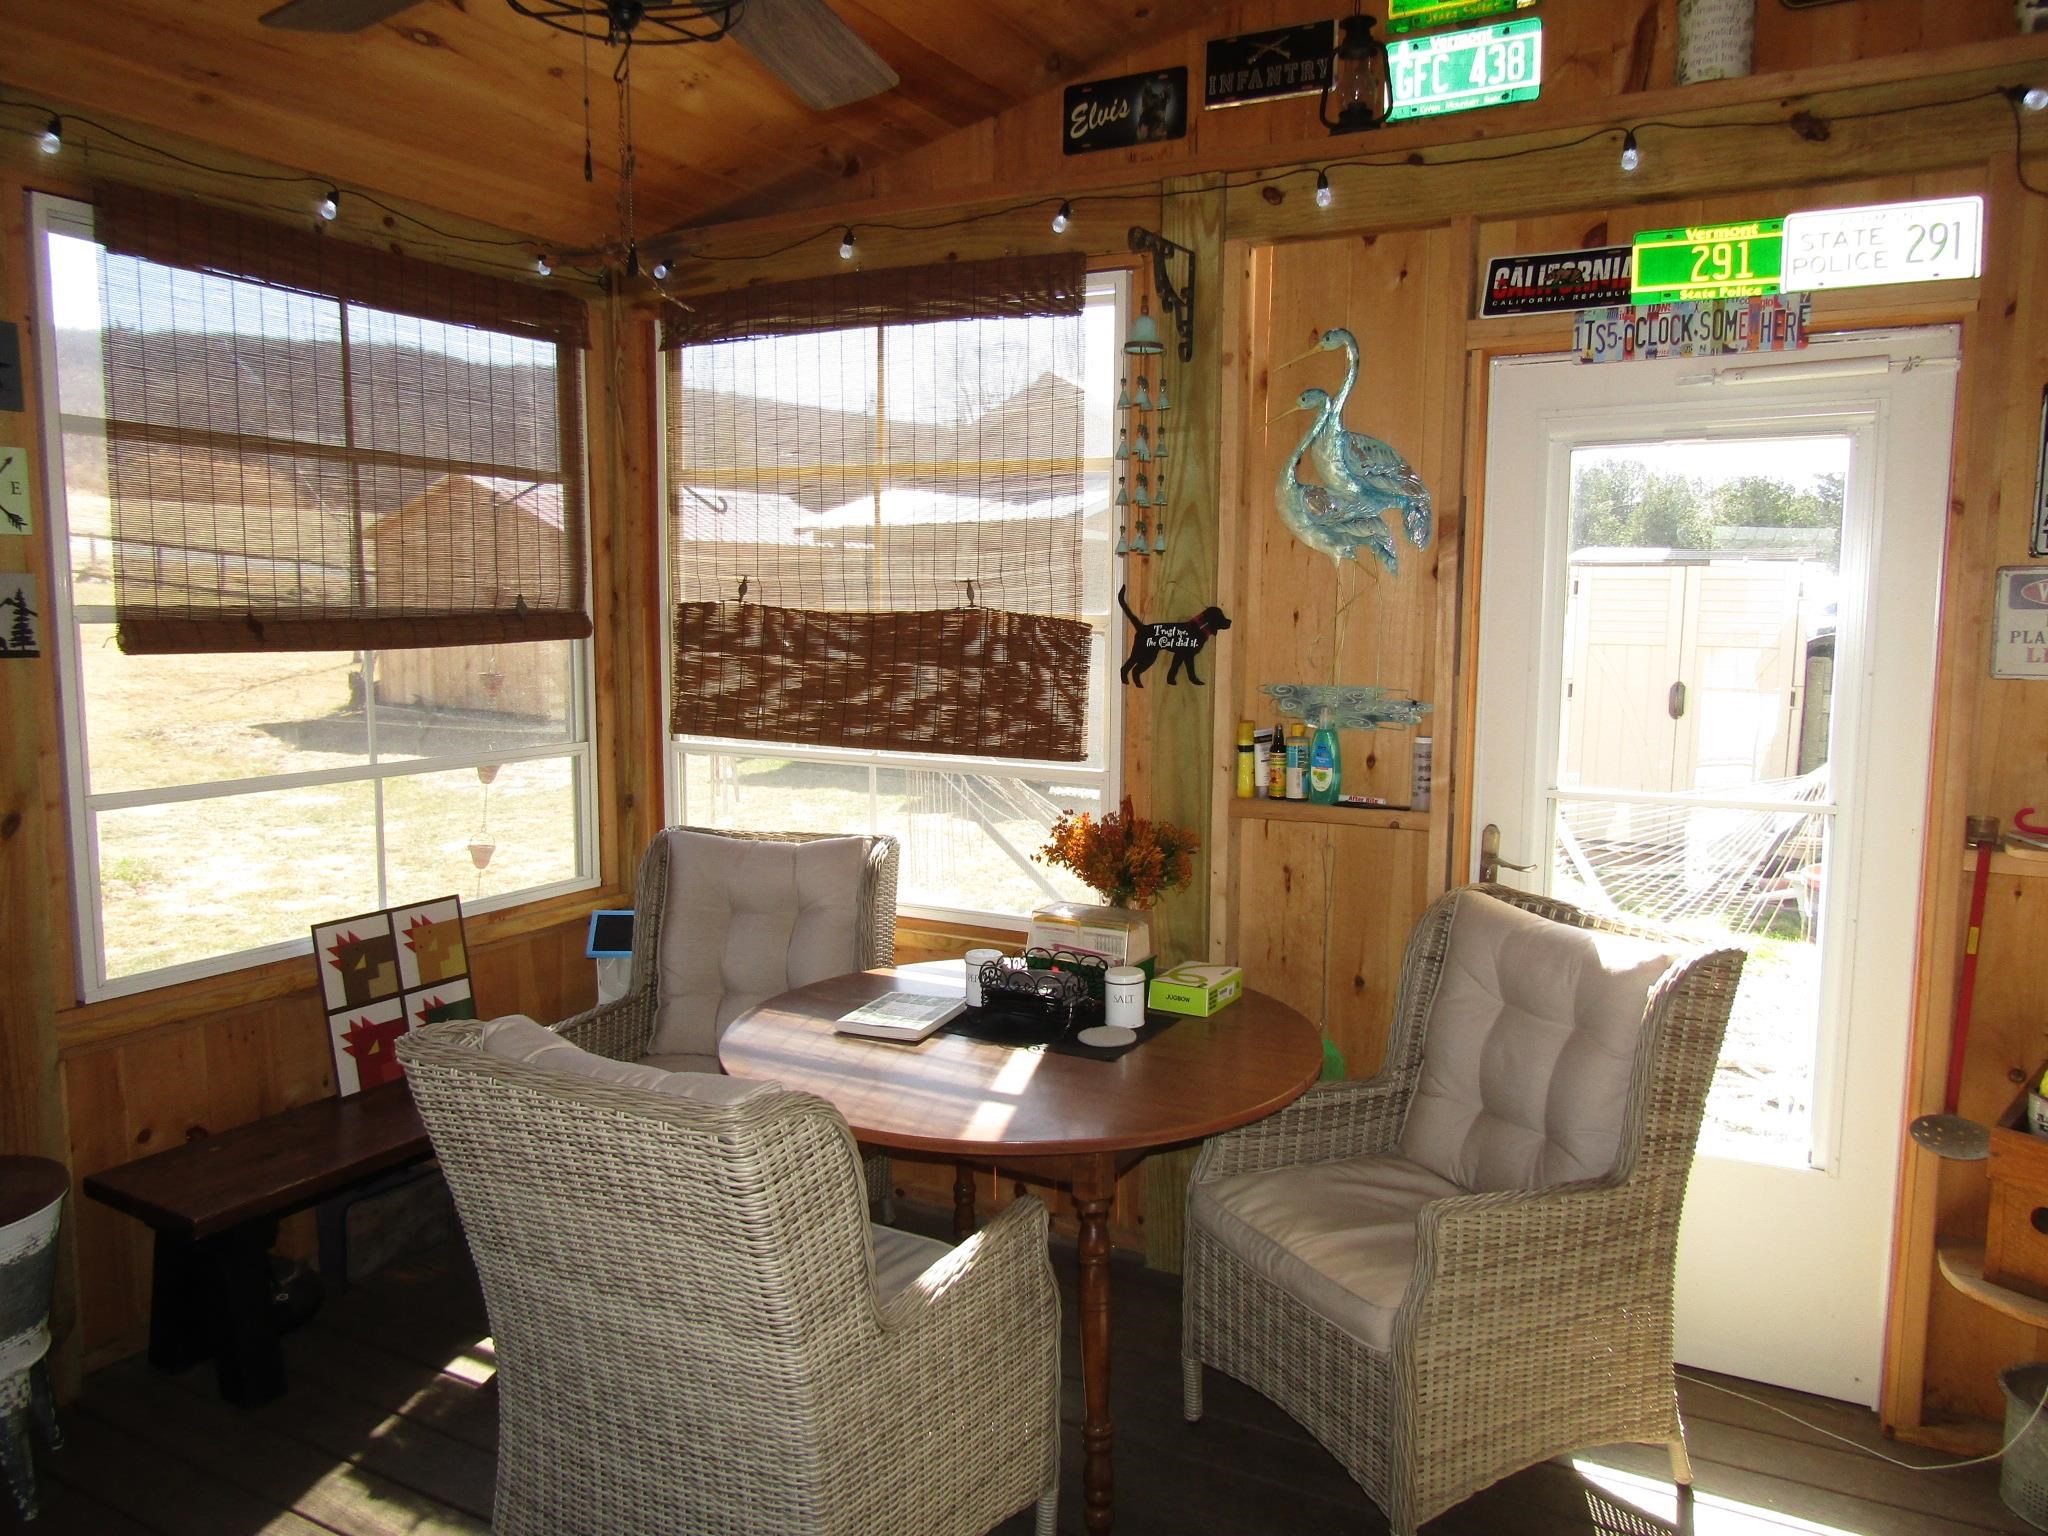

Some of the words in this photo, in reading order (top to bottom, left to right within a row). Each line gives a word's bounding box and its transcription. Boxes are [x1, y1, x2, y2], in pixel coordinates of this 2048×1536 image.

[1430, 27, 1493, 49] Vermont
[1208, 58, 1329, 96] INFANTRY
[1396, 54, 1449, 100] GFC
[1468, 41, 1525, 88] 438
[1070, 97, 1131, 139] Elvis
[1685, 223, 1760, 242] Vermont
[1801, 227, 1885, 252] STATE
[1905, 221, 1961, 264] 291
[1690, 241, 1754, 282] 291
[1793, 251, 1889, 275] POLICE
[1492, 295, 1565, 307] CALIFORNIA
[1679, 288, 1716, 300] State
[1719, 285, 1762, 299] Police
[11, 481, 22, 495] E
[1153, 624, 1176, 637] Trust
[1146, 637, 1156, 648] the
[1158, 636, 1174, 648] Cat
[1176, 637, 1189, 647] did
[1113, 994, 1135, 1004] SALT
[1165, 994, 1191, 1003] JUGBOW
